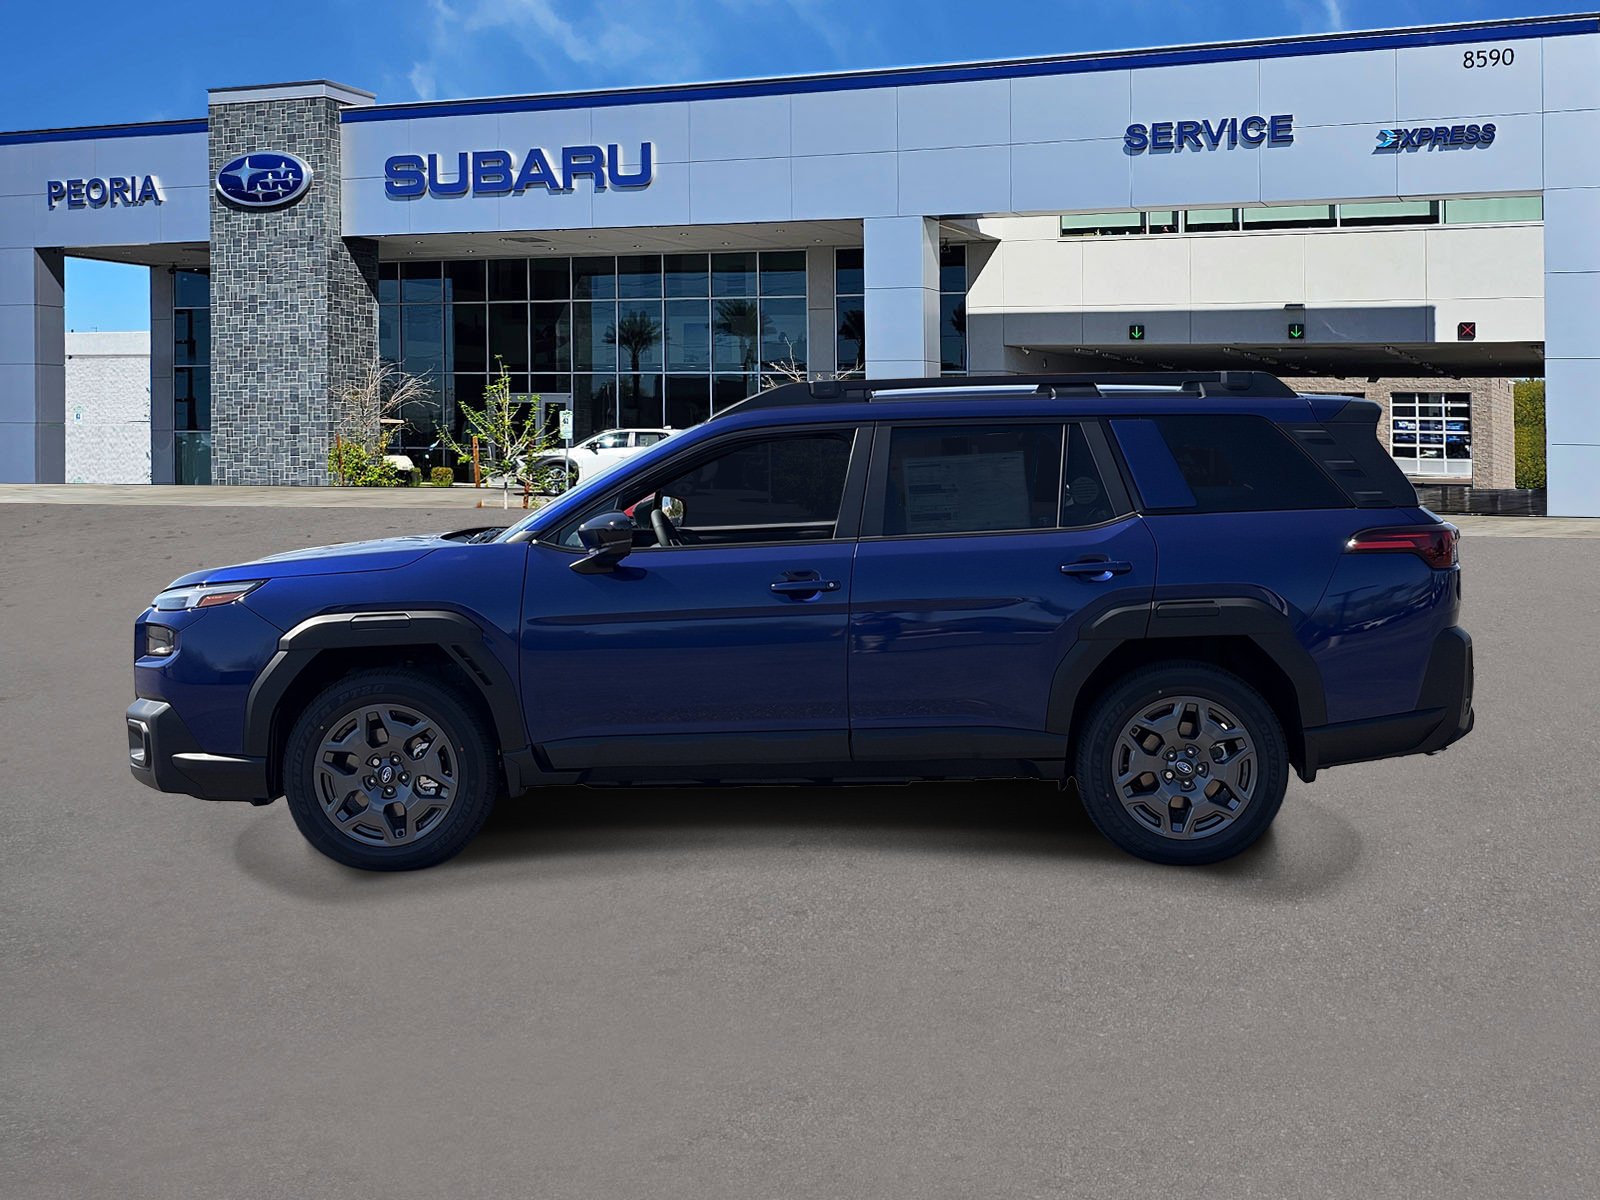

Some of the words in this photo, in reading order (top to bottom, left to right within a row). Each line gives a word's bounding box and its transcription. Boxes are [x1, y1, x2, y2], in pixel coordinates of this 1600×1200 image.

[1463, 48, 1514, 69] 8590
[1125, 114, 1294, 151] SERVICE
[1375, 123, 1496, 150] EXPRESS
[384, 142, 652, 198] SUBARU
[47, 175, 163, 210] PEORIA
